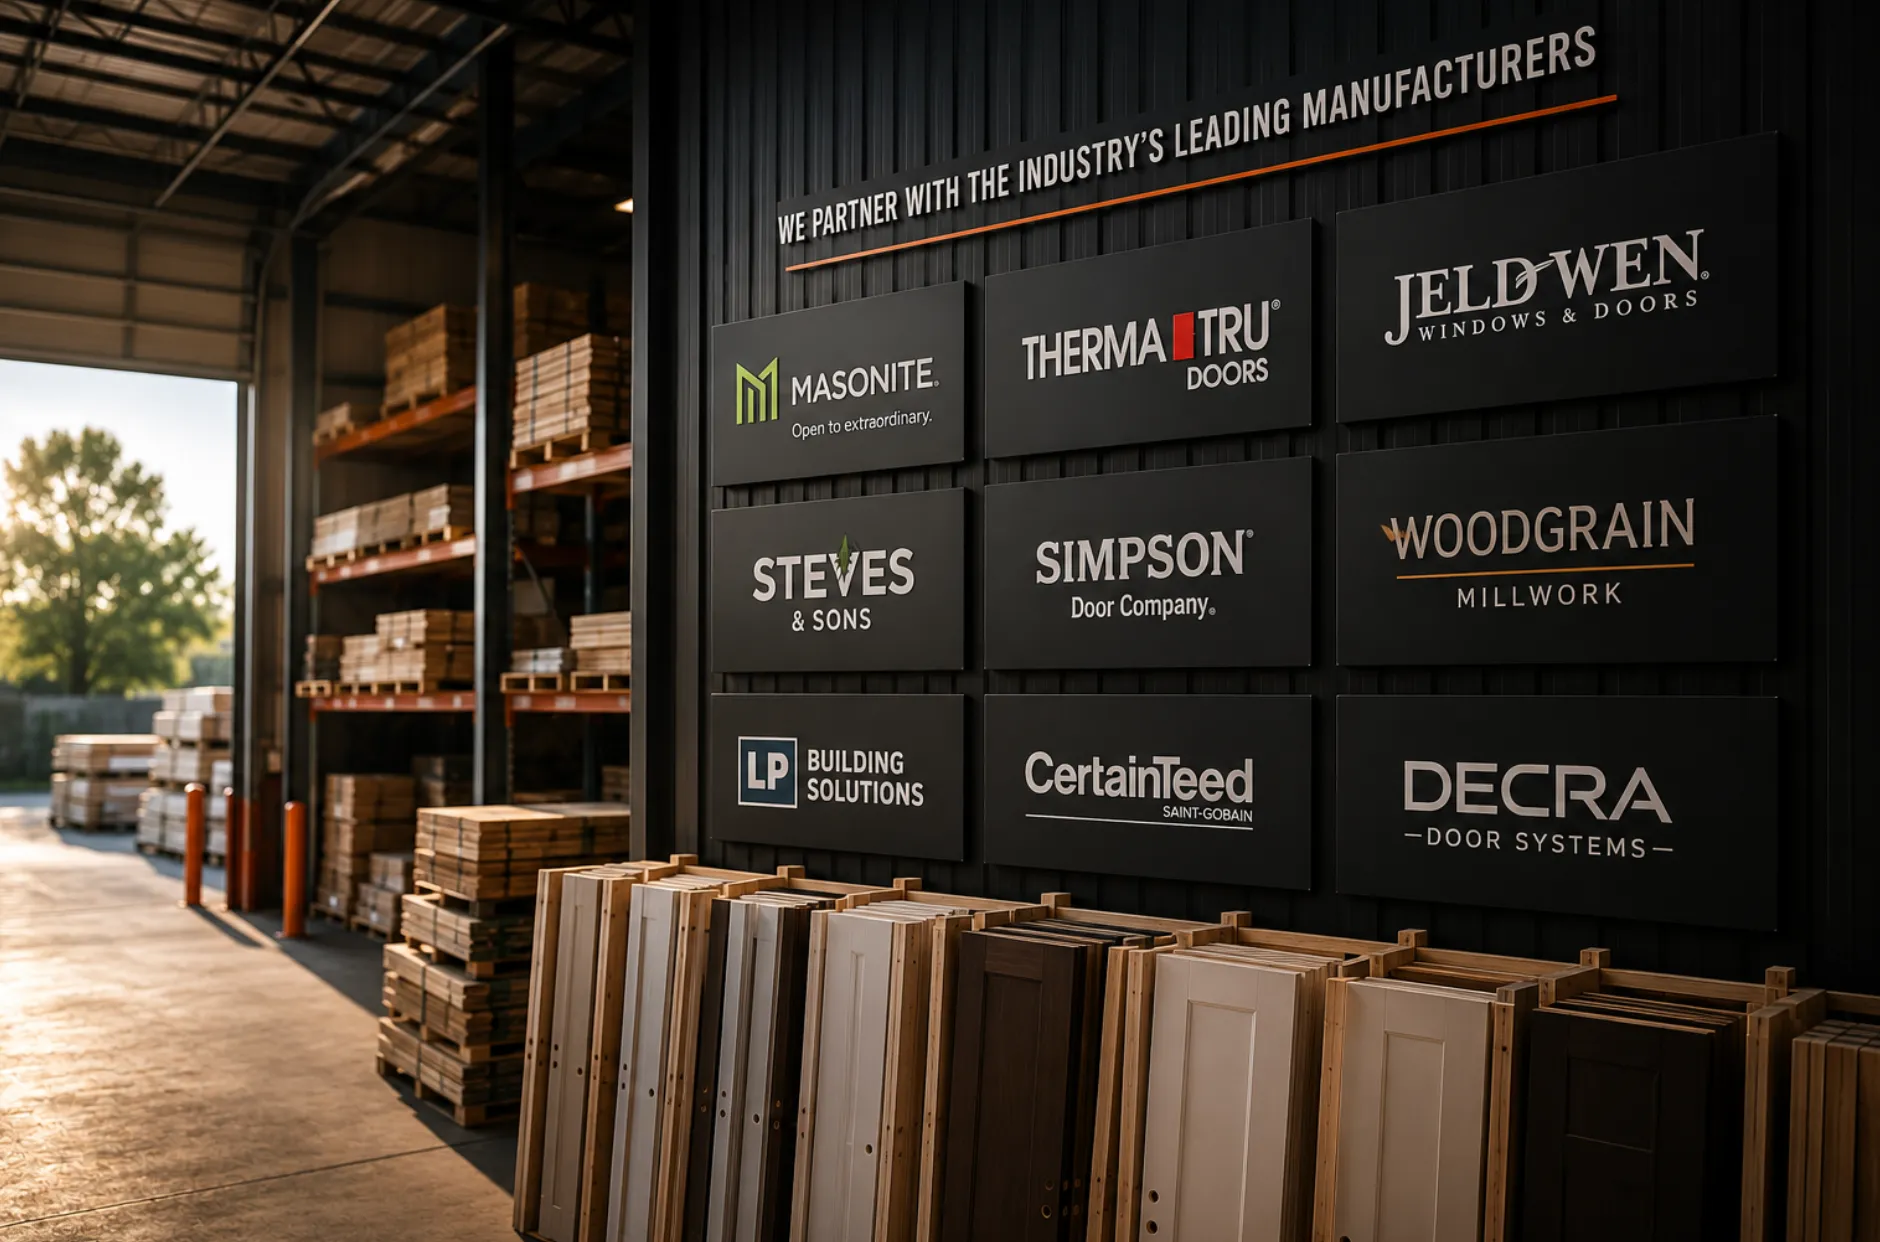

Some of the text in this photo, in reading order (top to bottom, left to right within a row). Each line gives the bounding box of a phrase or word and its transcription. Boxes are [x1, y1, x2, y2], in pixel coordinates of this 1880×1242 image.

[778, 211, 806, 245] WE
[812, 191, 898, 237] PARTNER
[905, 175, 960, 217] WITH
[967, 163, 1010, 203] THE
[1174, 97, 1291, 158] LEADING
[1303, 25, 1597, 129] MANUFACTURERS
[1418, 290, 1698, 342] WINDOWS & DOORS
[1021, 317, 1167, 380] THERMA
[1187, 357, 1269, 391] DOORS
[792, 410, 933, 440] Open to extraordinary.
[1391, 497, 1695, 560] WOODGRAIN
[752, 547, 915, 601] STEVES
[1071, 596, 1115, 618] Door
[1458, 582, 1622, 608] MILLWORK
[791, 607, 872, 631] & SONS
[747, 751, 789, 790] LP
[807, 749, 904, 775] BUILDING
[1024, 751, 1253, 803] CertainTeed
[807, 777, 924, 807] SOLUTIONS
[1404, 760, 1673, 824] DECRA
[1162, 805, 1253, 822] SAINT-GOBAIN
[1427, 827, 1646, 859] DOOR SYSTEMS
